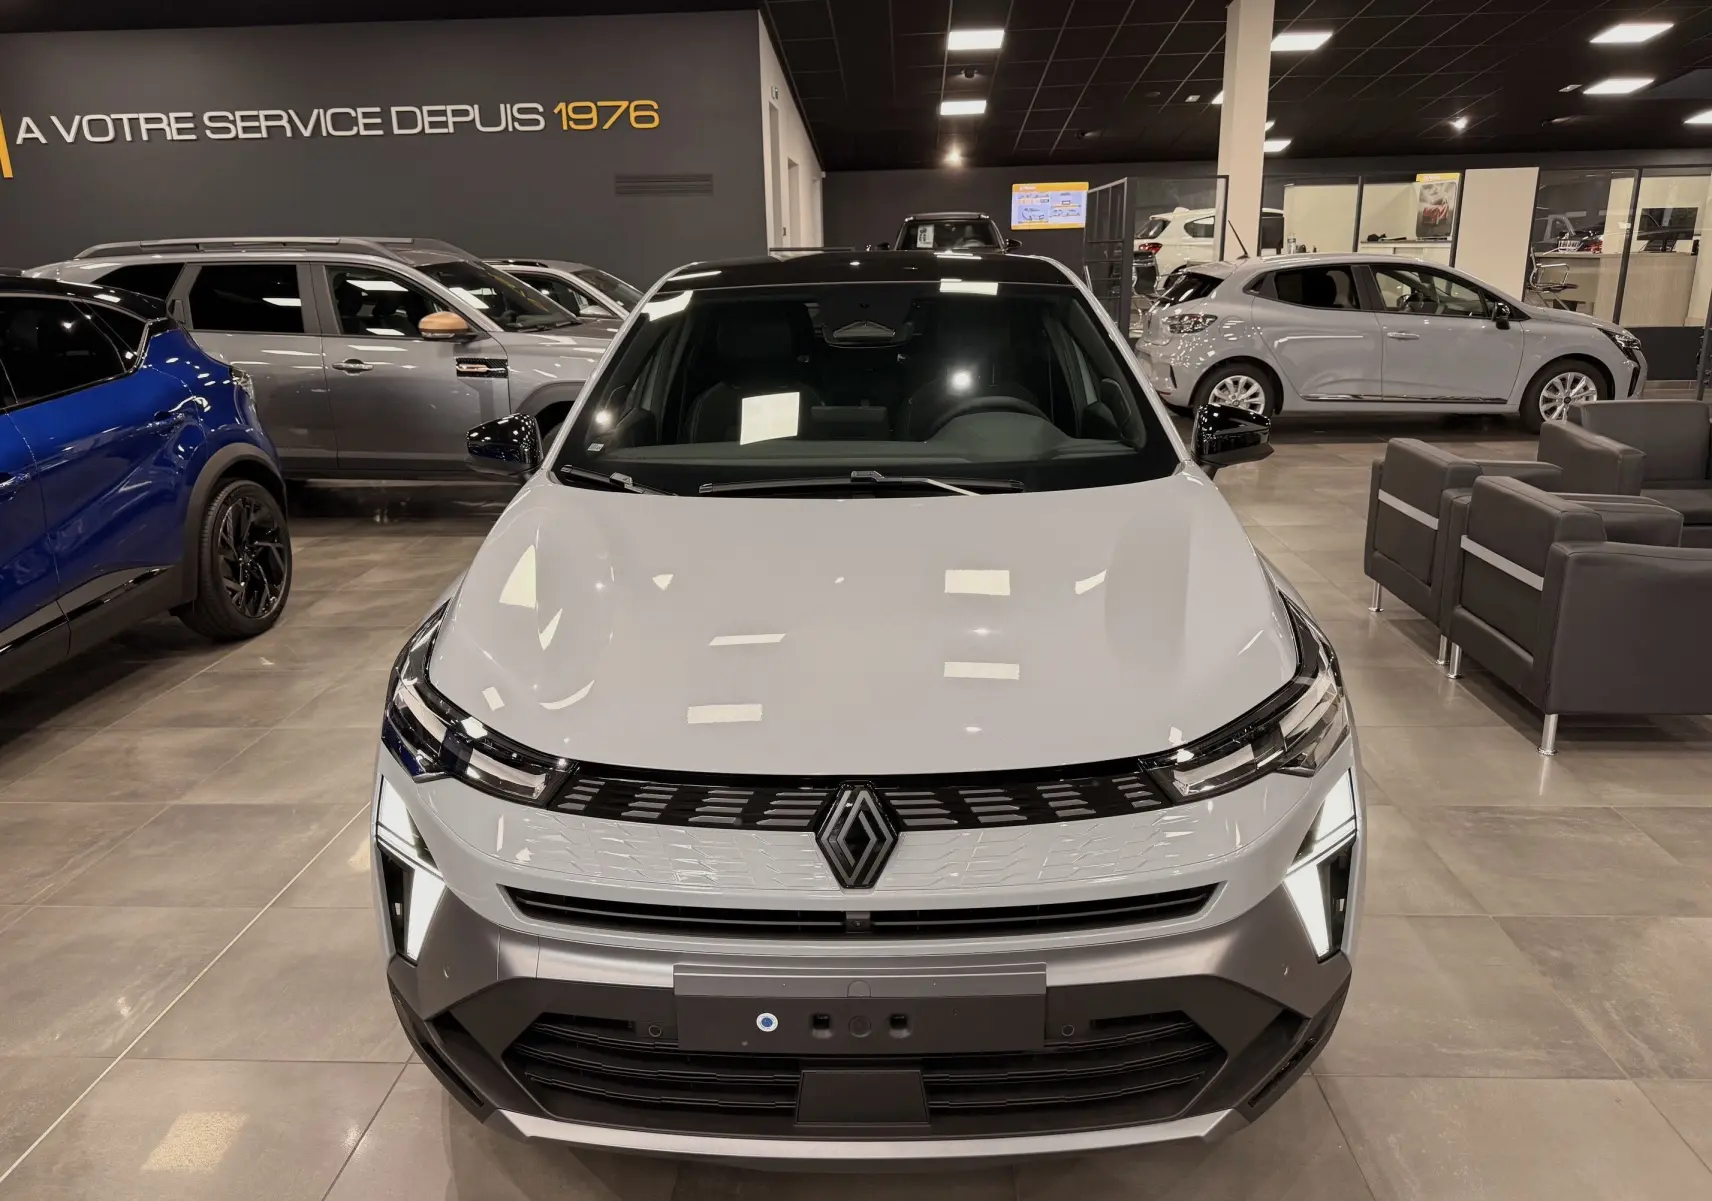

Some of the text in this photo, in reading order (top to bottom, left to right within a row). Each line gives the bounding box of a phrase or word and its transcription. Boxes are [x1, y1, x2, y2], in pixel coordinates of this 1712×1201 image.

[15, 99, 660, 145] A VOTRE SERVICE DEPUIS 1976
